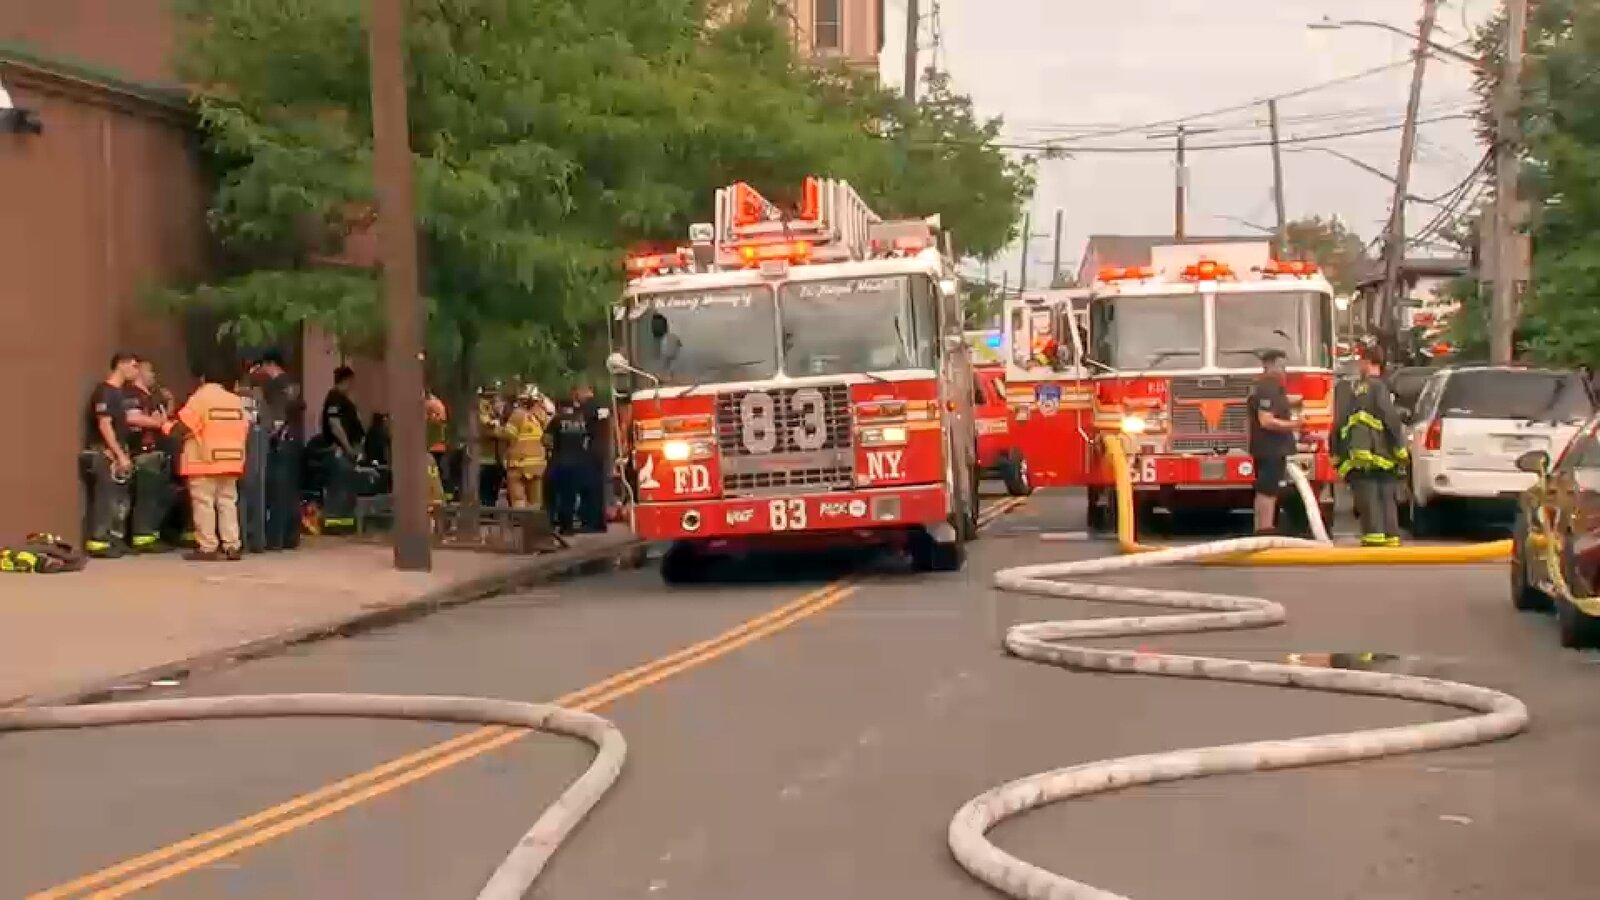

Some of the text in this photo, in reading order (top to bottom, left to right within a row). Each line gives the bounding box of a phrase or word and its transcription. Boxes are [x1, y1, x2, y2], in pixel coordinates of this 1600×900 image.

[742, 388, 827, 454] 83
[673, 450, 906, 494] F.D. N.Y.
[769, 499, 807, 531] 83
